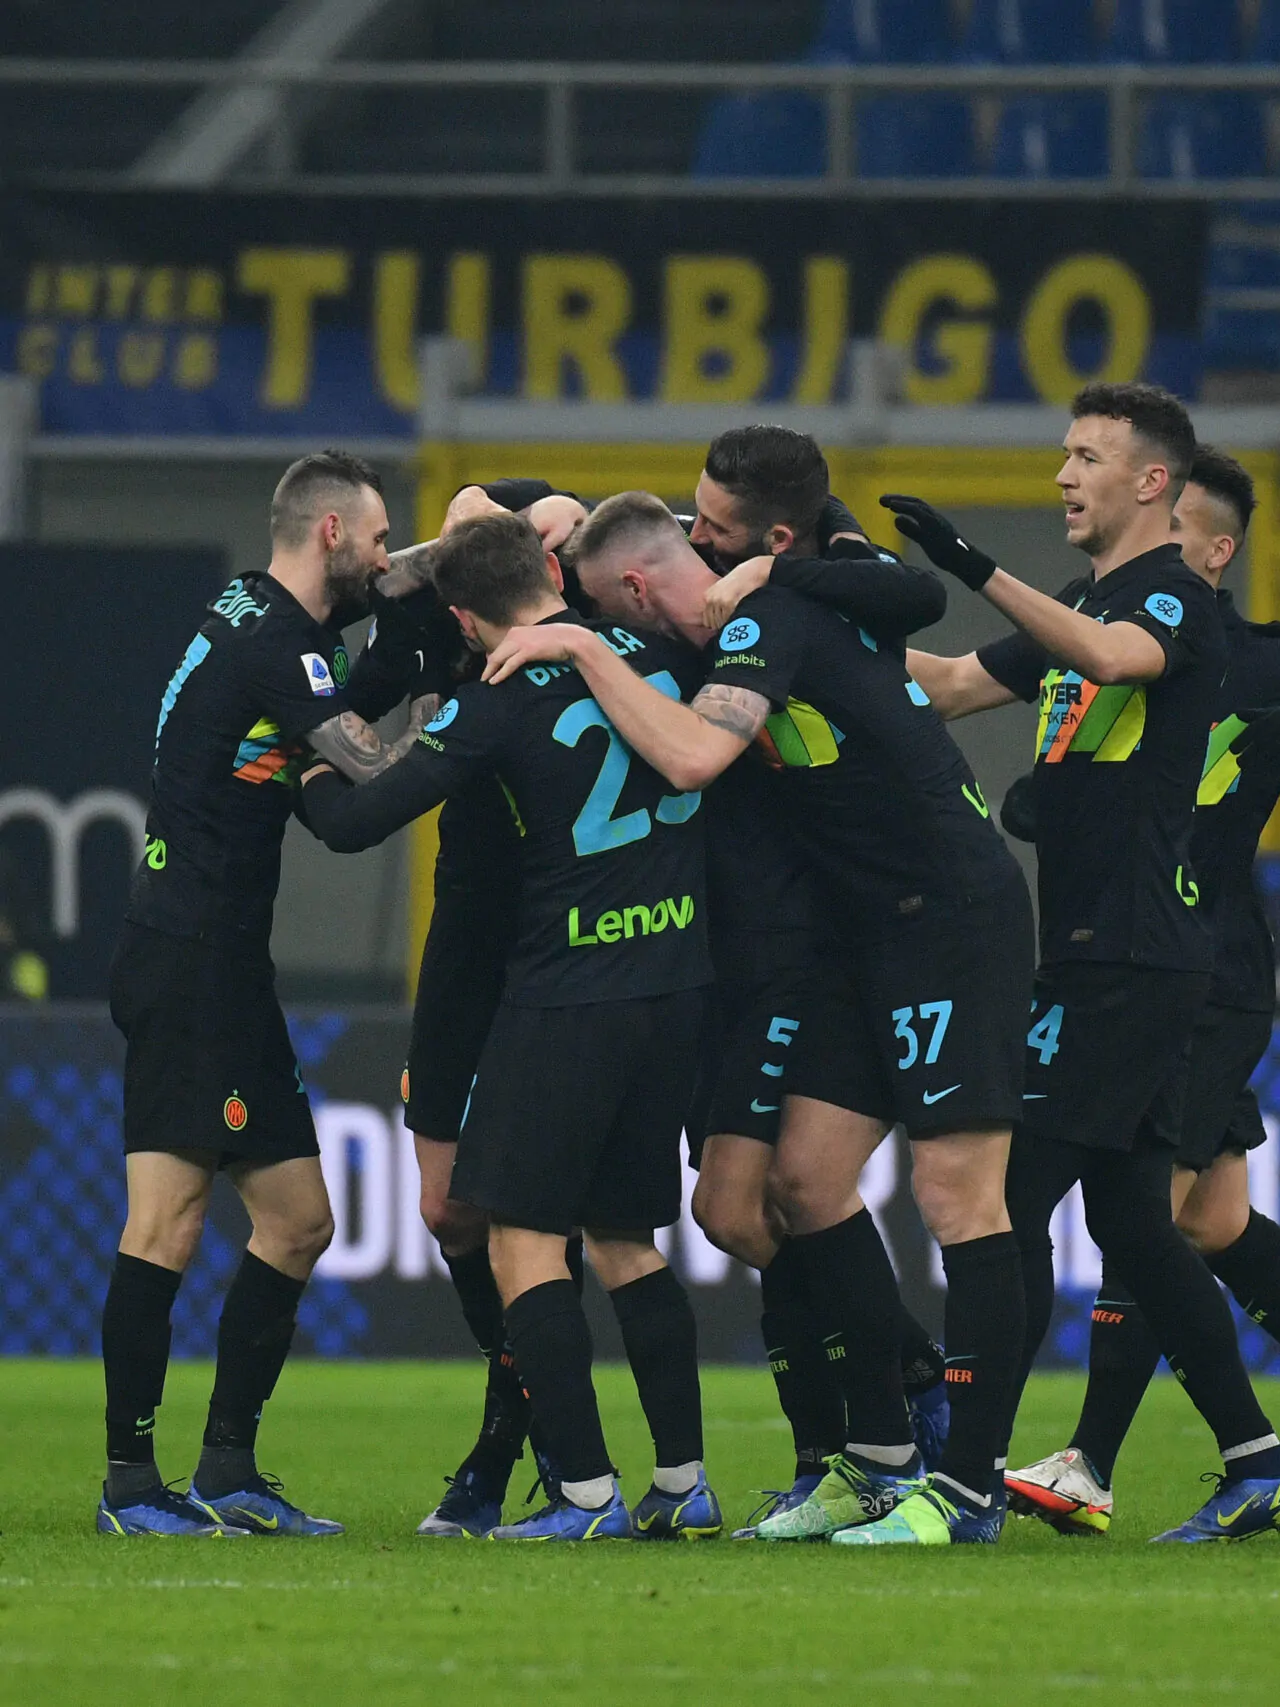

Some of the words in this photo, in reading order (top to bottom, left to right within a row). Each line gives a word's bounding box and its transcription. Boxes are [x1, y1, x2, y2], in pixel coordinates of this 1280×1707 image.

[236, 248, 1154, 410] TURBIGO
[760, 1016, 800, 1077] 5
[892, 1000, 953, 1070] 37
[1027, 999, 1065, 1066] 4
